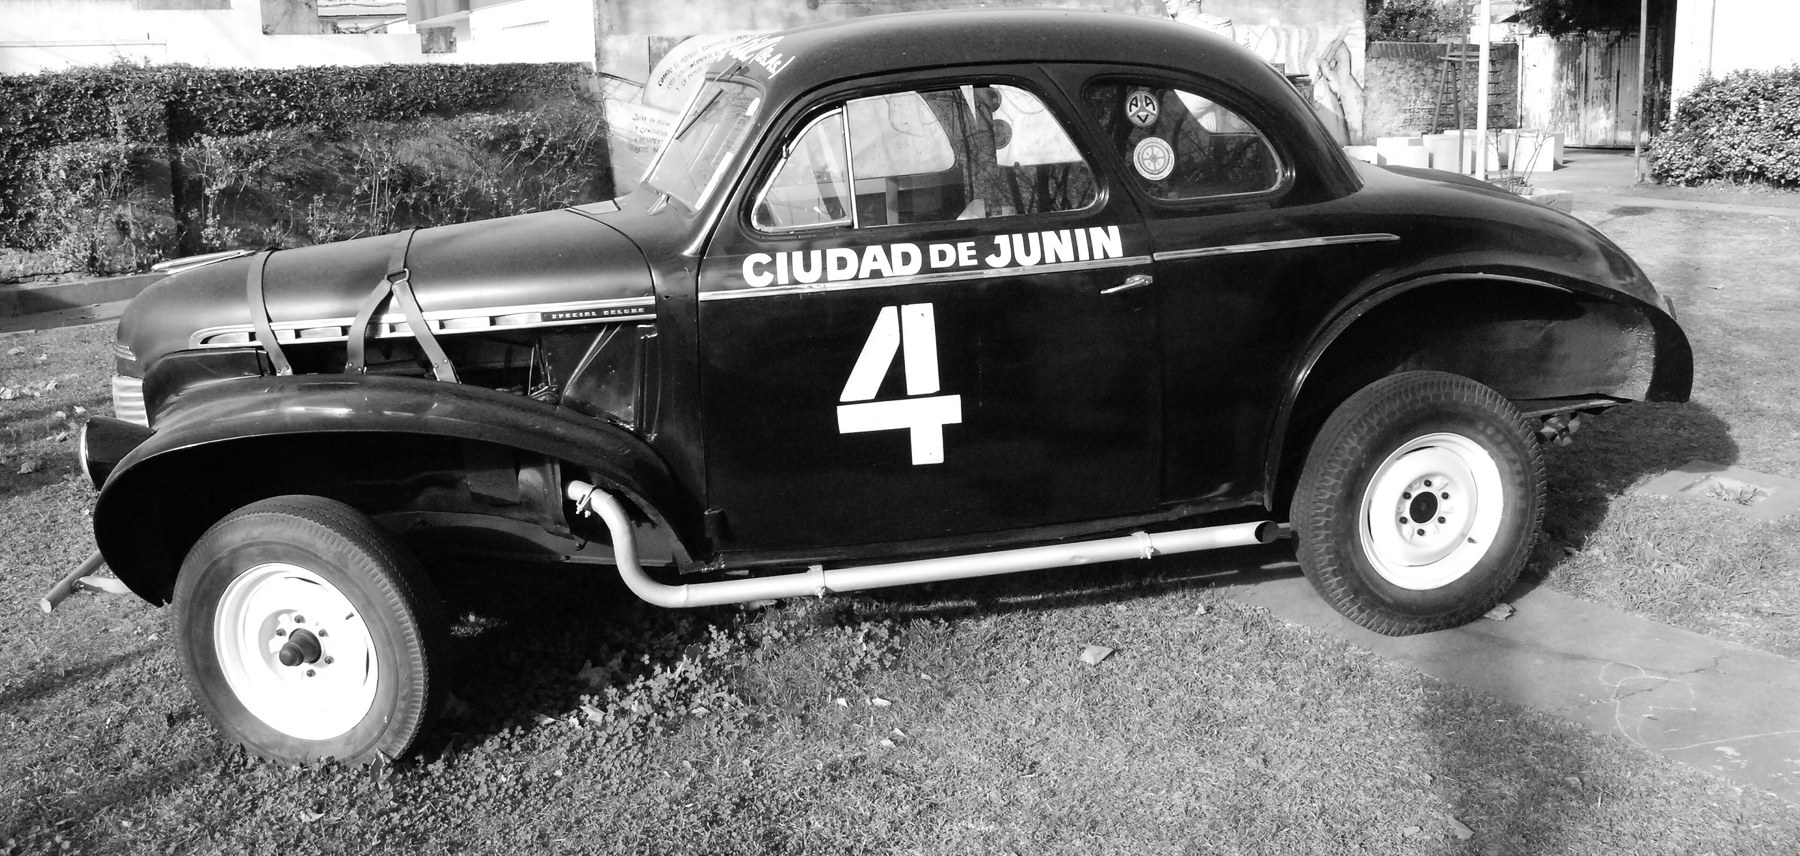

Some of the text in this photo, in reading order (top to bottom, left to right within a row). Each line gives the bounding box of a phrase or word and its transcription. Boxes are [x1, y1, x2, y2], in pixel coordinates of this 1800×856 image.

[742, 225, 1123, 287] CIUDAD DE JUNIN
[603, 307, 645, 316] DELUXE
[837, 302, 962, 465] 4
